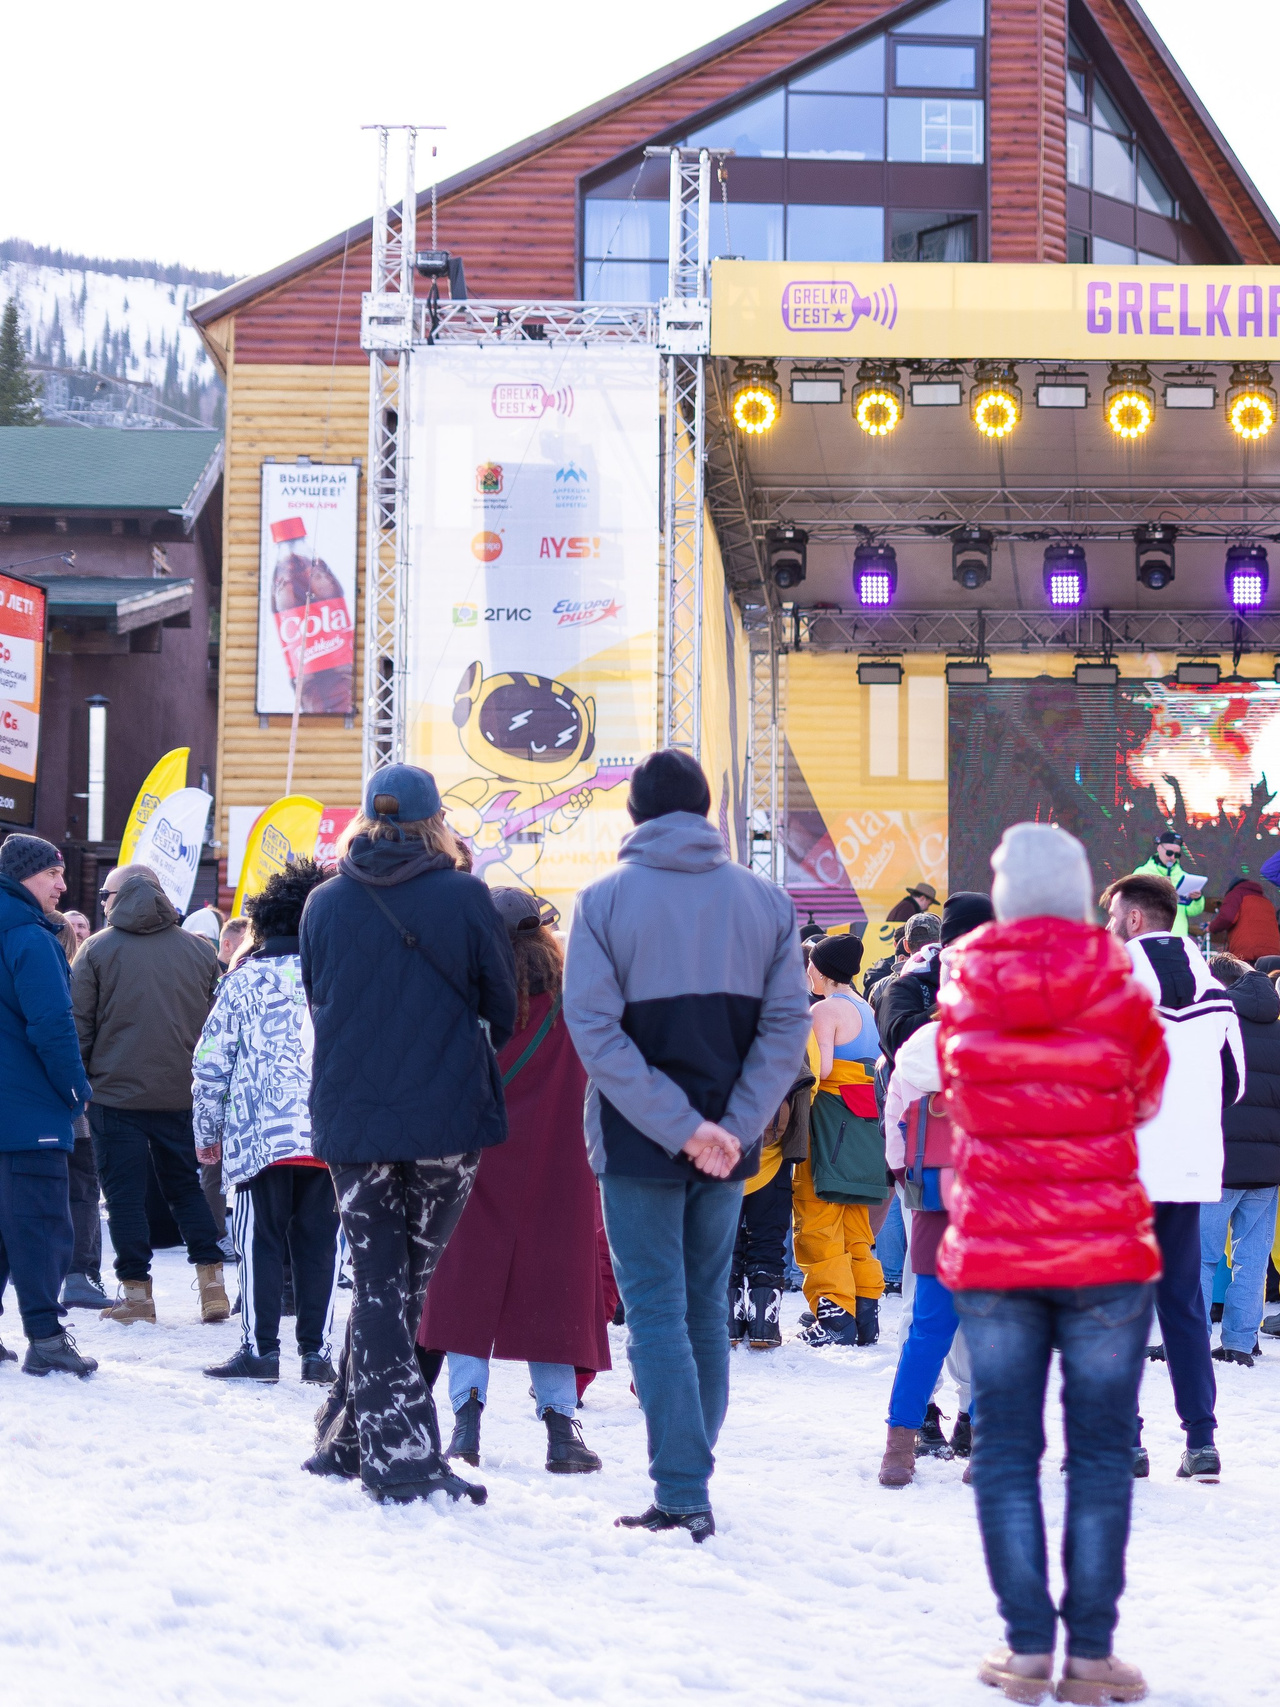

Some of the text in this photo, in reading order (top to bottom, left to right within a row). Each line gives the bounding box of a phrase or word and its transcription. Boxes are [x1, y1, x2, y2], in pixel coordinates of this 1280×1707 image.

[794, 288, 848, 304] GRELKA
[793, 308, 830, 324] FEST
[500, 388, 539, 400] GRELKA
[500, 402, 526, 414] FEST
[280, 472, 347, 484] ВЫБИРАЙ
[539, 536, 601, 559] AYS!
[484, 607, 532, 621] 2ГИС
[280, 605, 348, 644] Cola
[815, 810, 886, 885] Cola
